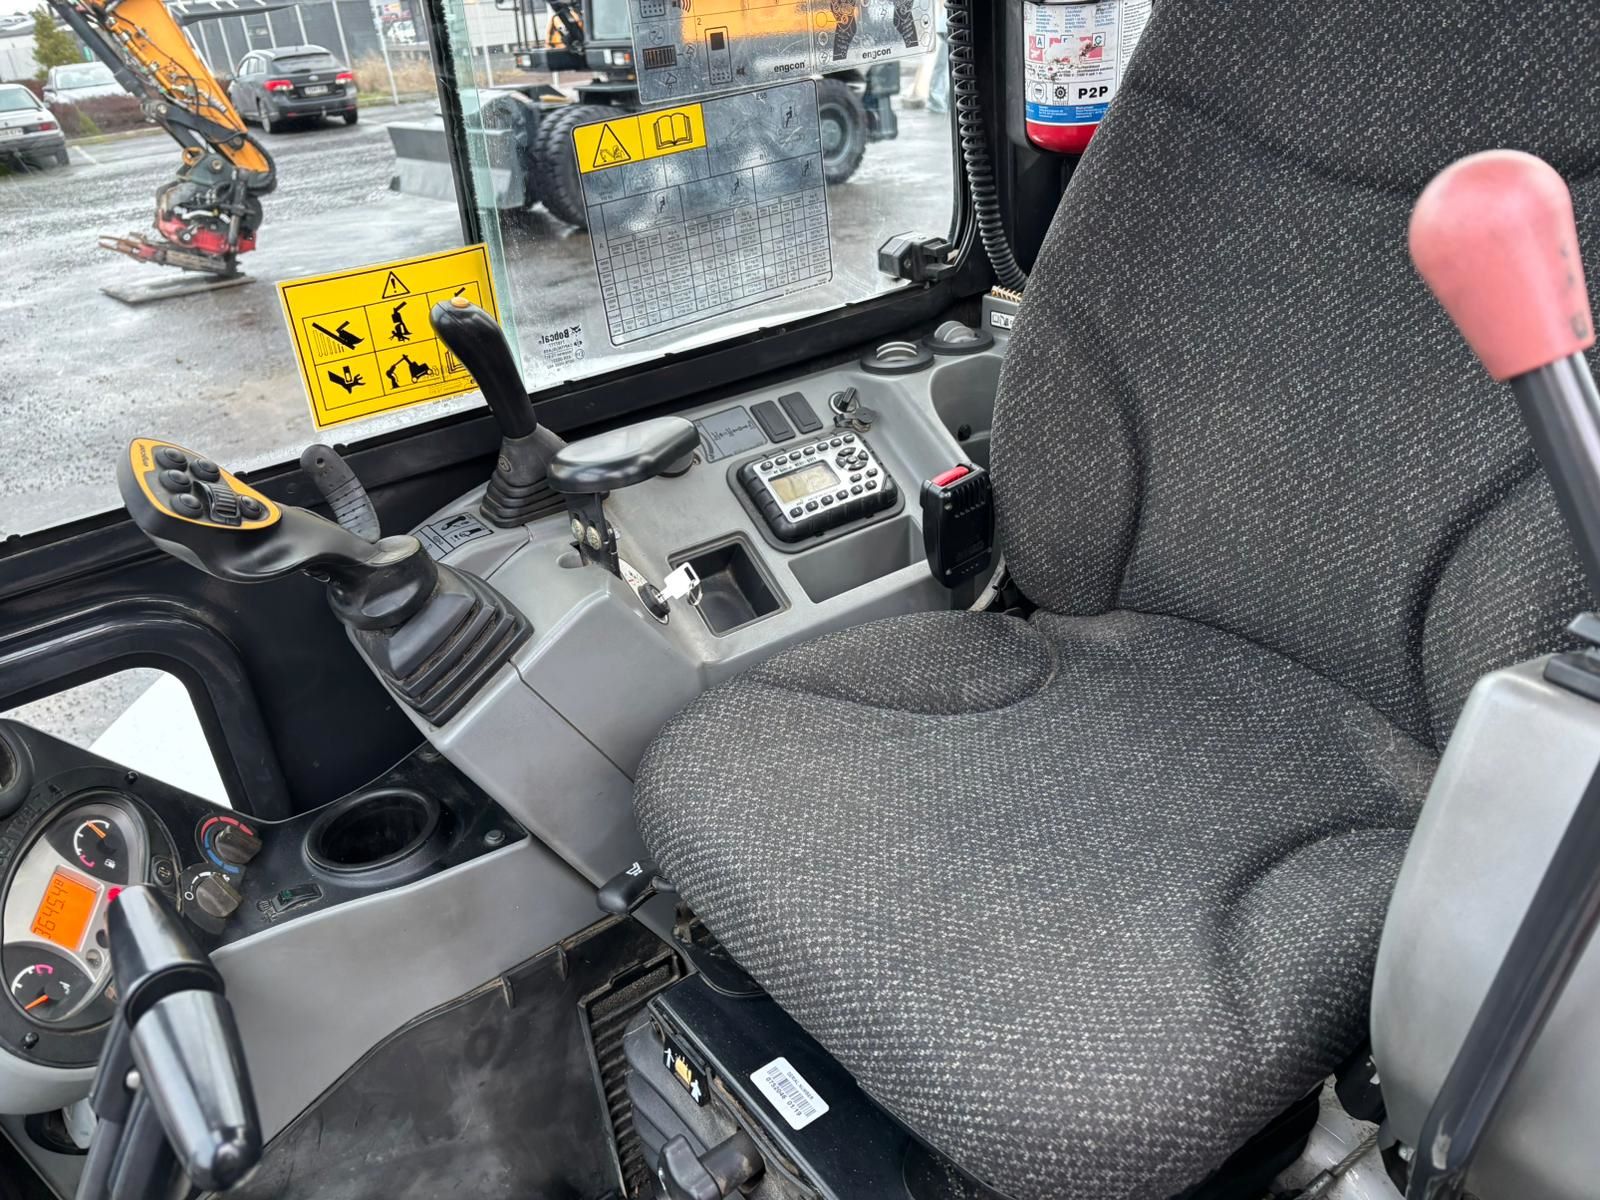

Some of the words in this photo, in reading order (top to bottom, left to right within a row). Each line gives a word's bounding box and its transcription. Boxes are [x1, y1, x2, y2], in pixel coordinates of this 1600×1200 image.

[862, 47, 892, 59] engcon
[773, 61, 805, 73] engcon
[1078, 86, 1108, 99] P2P
